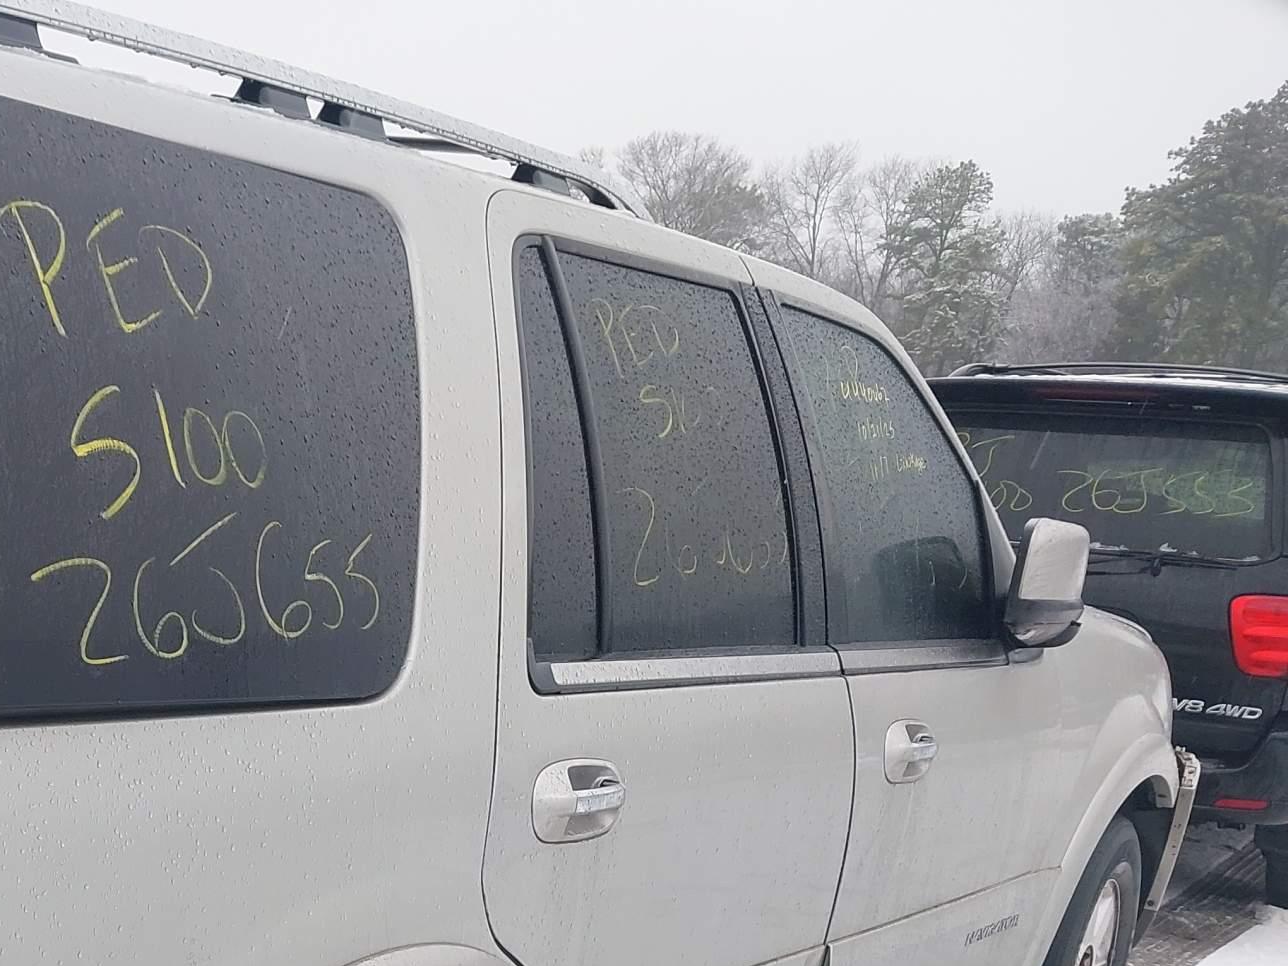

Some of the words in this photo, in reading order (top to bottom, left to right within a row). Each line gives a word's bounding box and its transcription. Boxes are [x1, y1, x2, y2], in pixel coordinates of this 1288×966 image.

[591, 297, 680, 379] PED
[29, 511, 382, 665] 26J655
[1172, 697, 1205, 713] V8
[1205, 703, 1263, 720] 4WD
